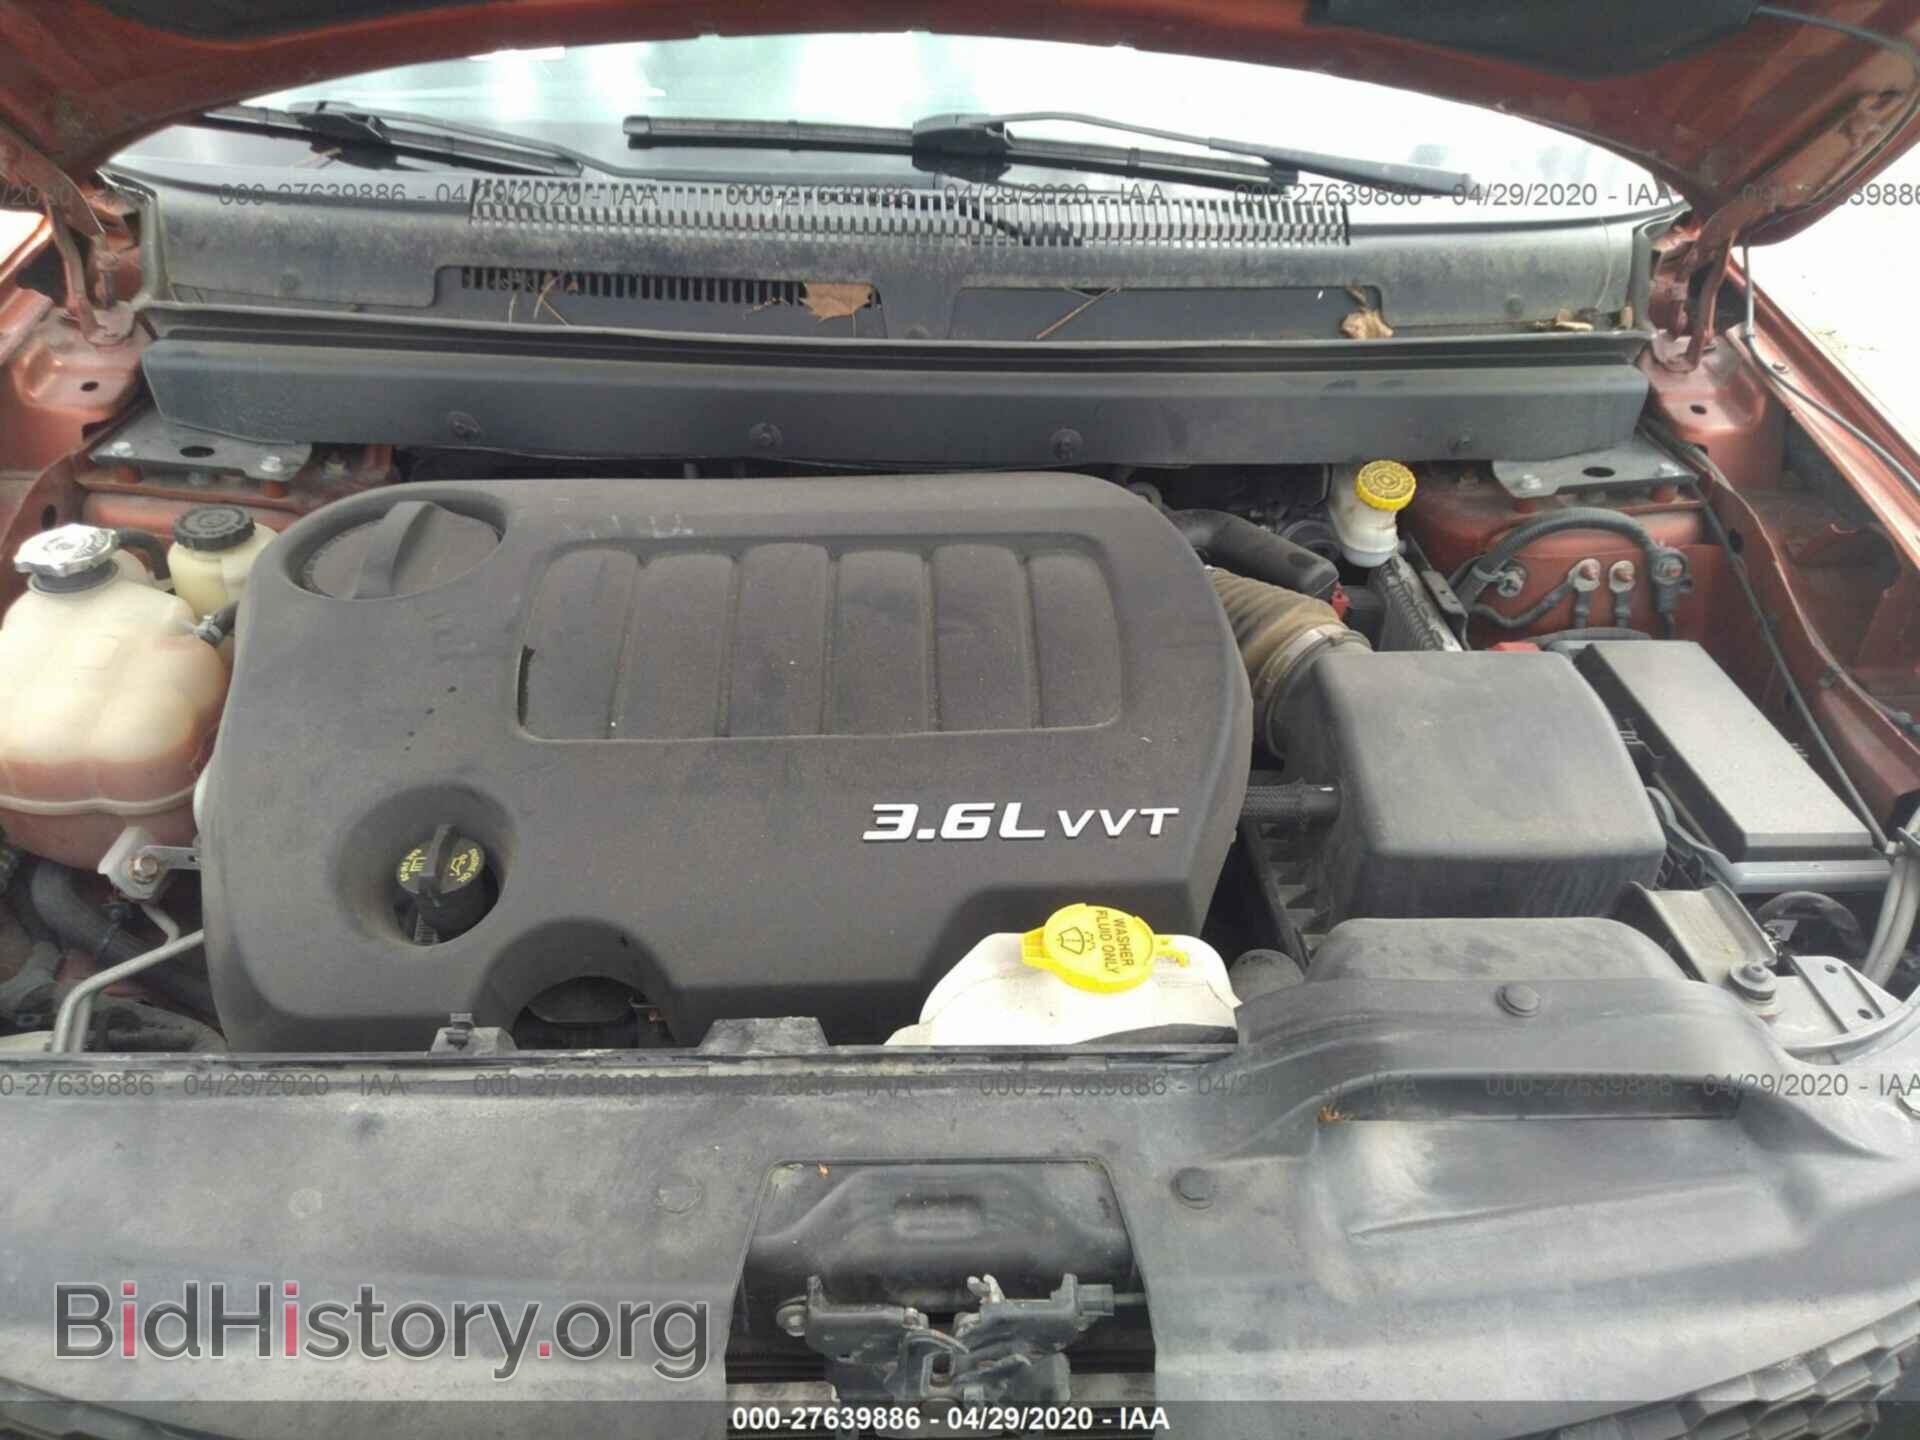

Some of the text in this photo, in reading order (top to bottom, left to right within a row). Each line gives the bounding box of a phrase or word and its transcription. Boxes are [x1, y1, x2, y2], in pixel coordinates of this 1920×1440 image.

[862, 802, 1180, 841] 3.6L VVT
[1096, 909, 1119, 974] FLUID ONLY
[1113, 917, 1135, 967] WASHER
